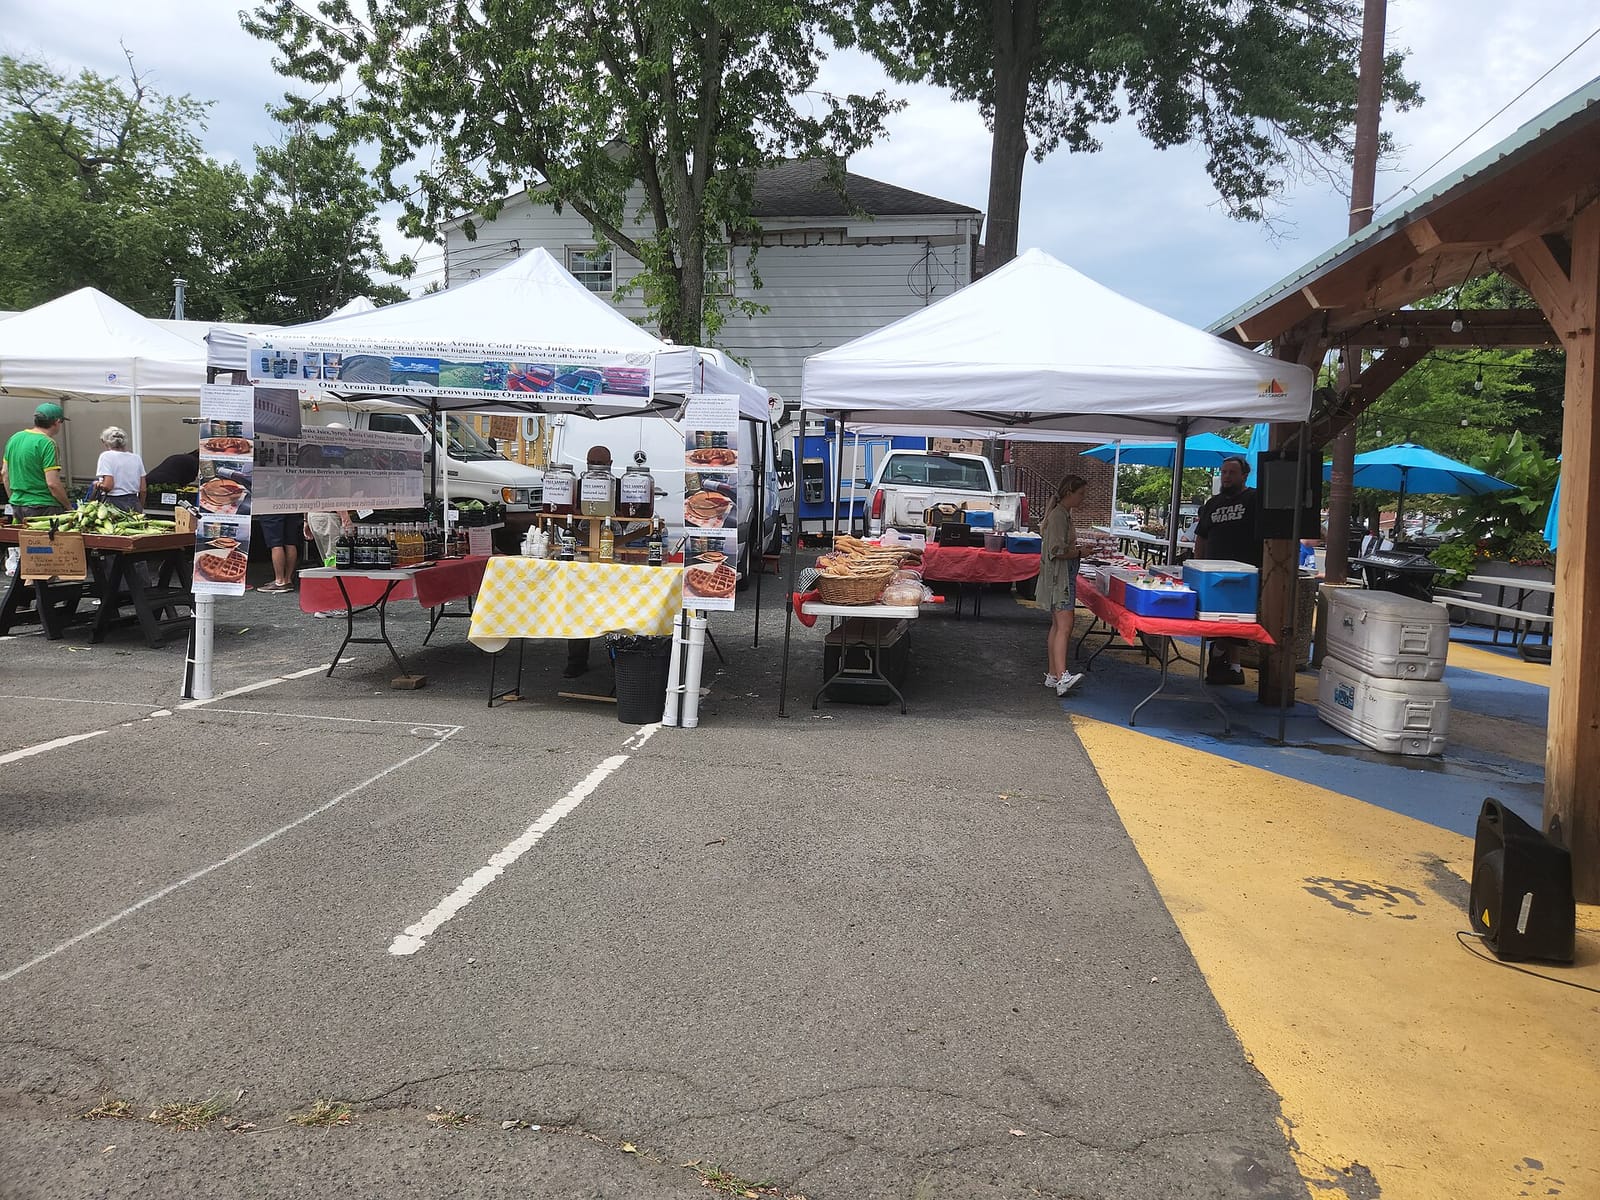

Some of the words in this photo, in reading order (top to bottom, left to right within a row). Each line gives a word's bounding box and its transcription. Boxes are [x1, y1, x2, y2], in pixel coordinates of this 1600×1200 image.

[373, 344, 396, 352] Super
[487, 342, 513, 350] Cold
[515, 343, 543, 351] Press
[544, 345, 576, 353] Juice,
[343, 383, 376, 391] Aronia
[379, 385, 415, 393] Berries
[437, 388, 469, 397] grown
[472, 390, 499, 398] using
[502, 391, 544, 399] Organic
[546, 393, 593, 402] practices
[1216, 503, 1246, 515] STAR
[1211, 511, 1245, 524] WARS
